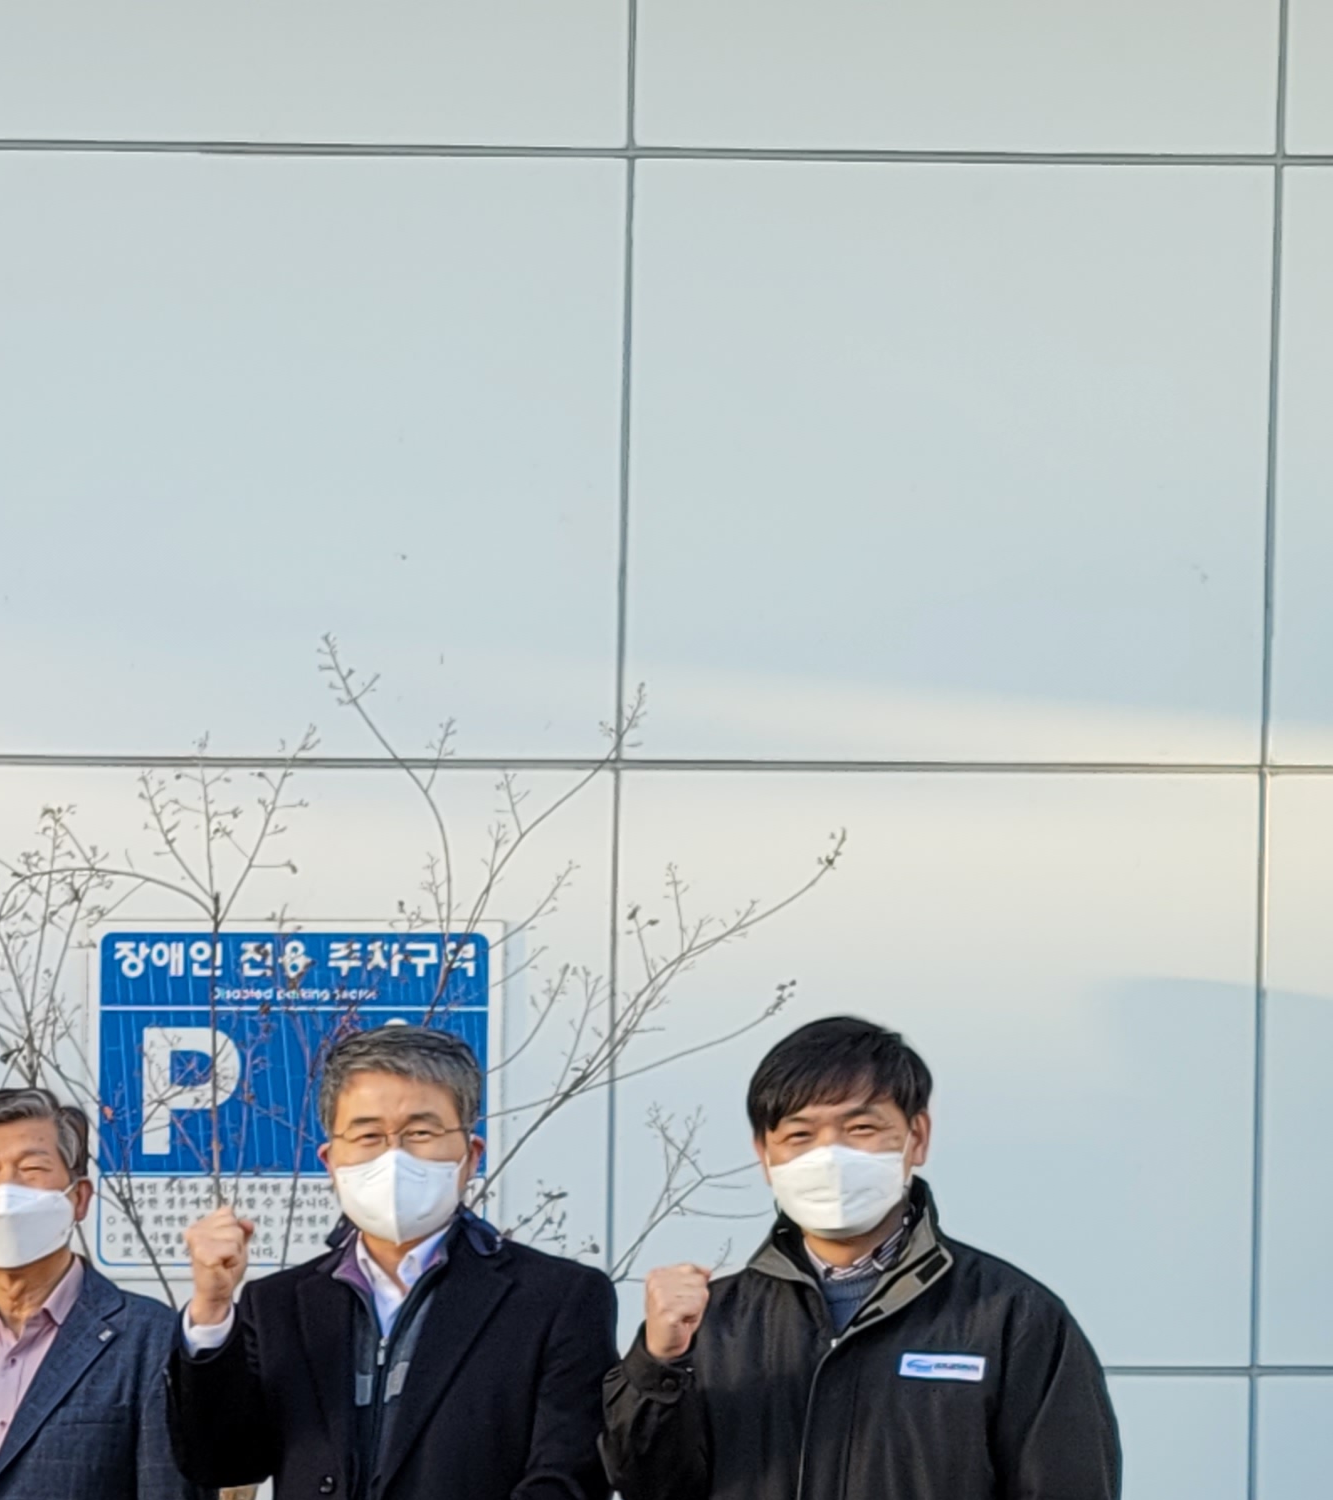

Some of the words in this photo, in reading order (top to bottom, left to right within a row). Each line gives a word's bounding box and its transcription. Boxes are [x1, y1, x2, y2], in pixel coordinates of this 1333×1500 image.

[114, 941, 223, 978] 장애인
[240, 940, 312, 979] 전용
[141, 1027, 242, 1156] P
